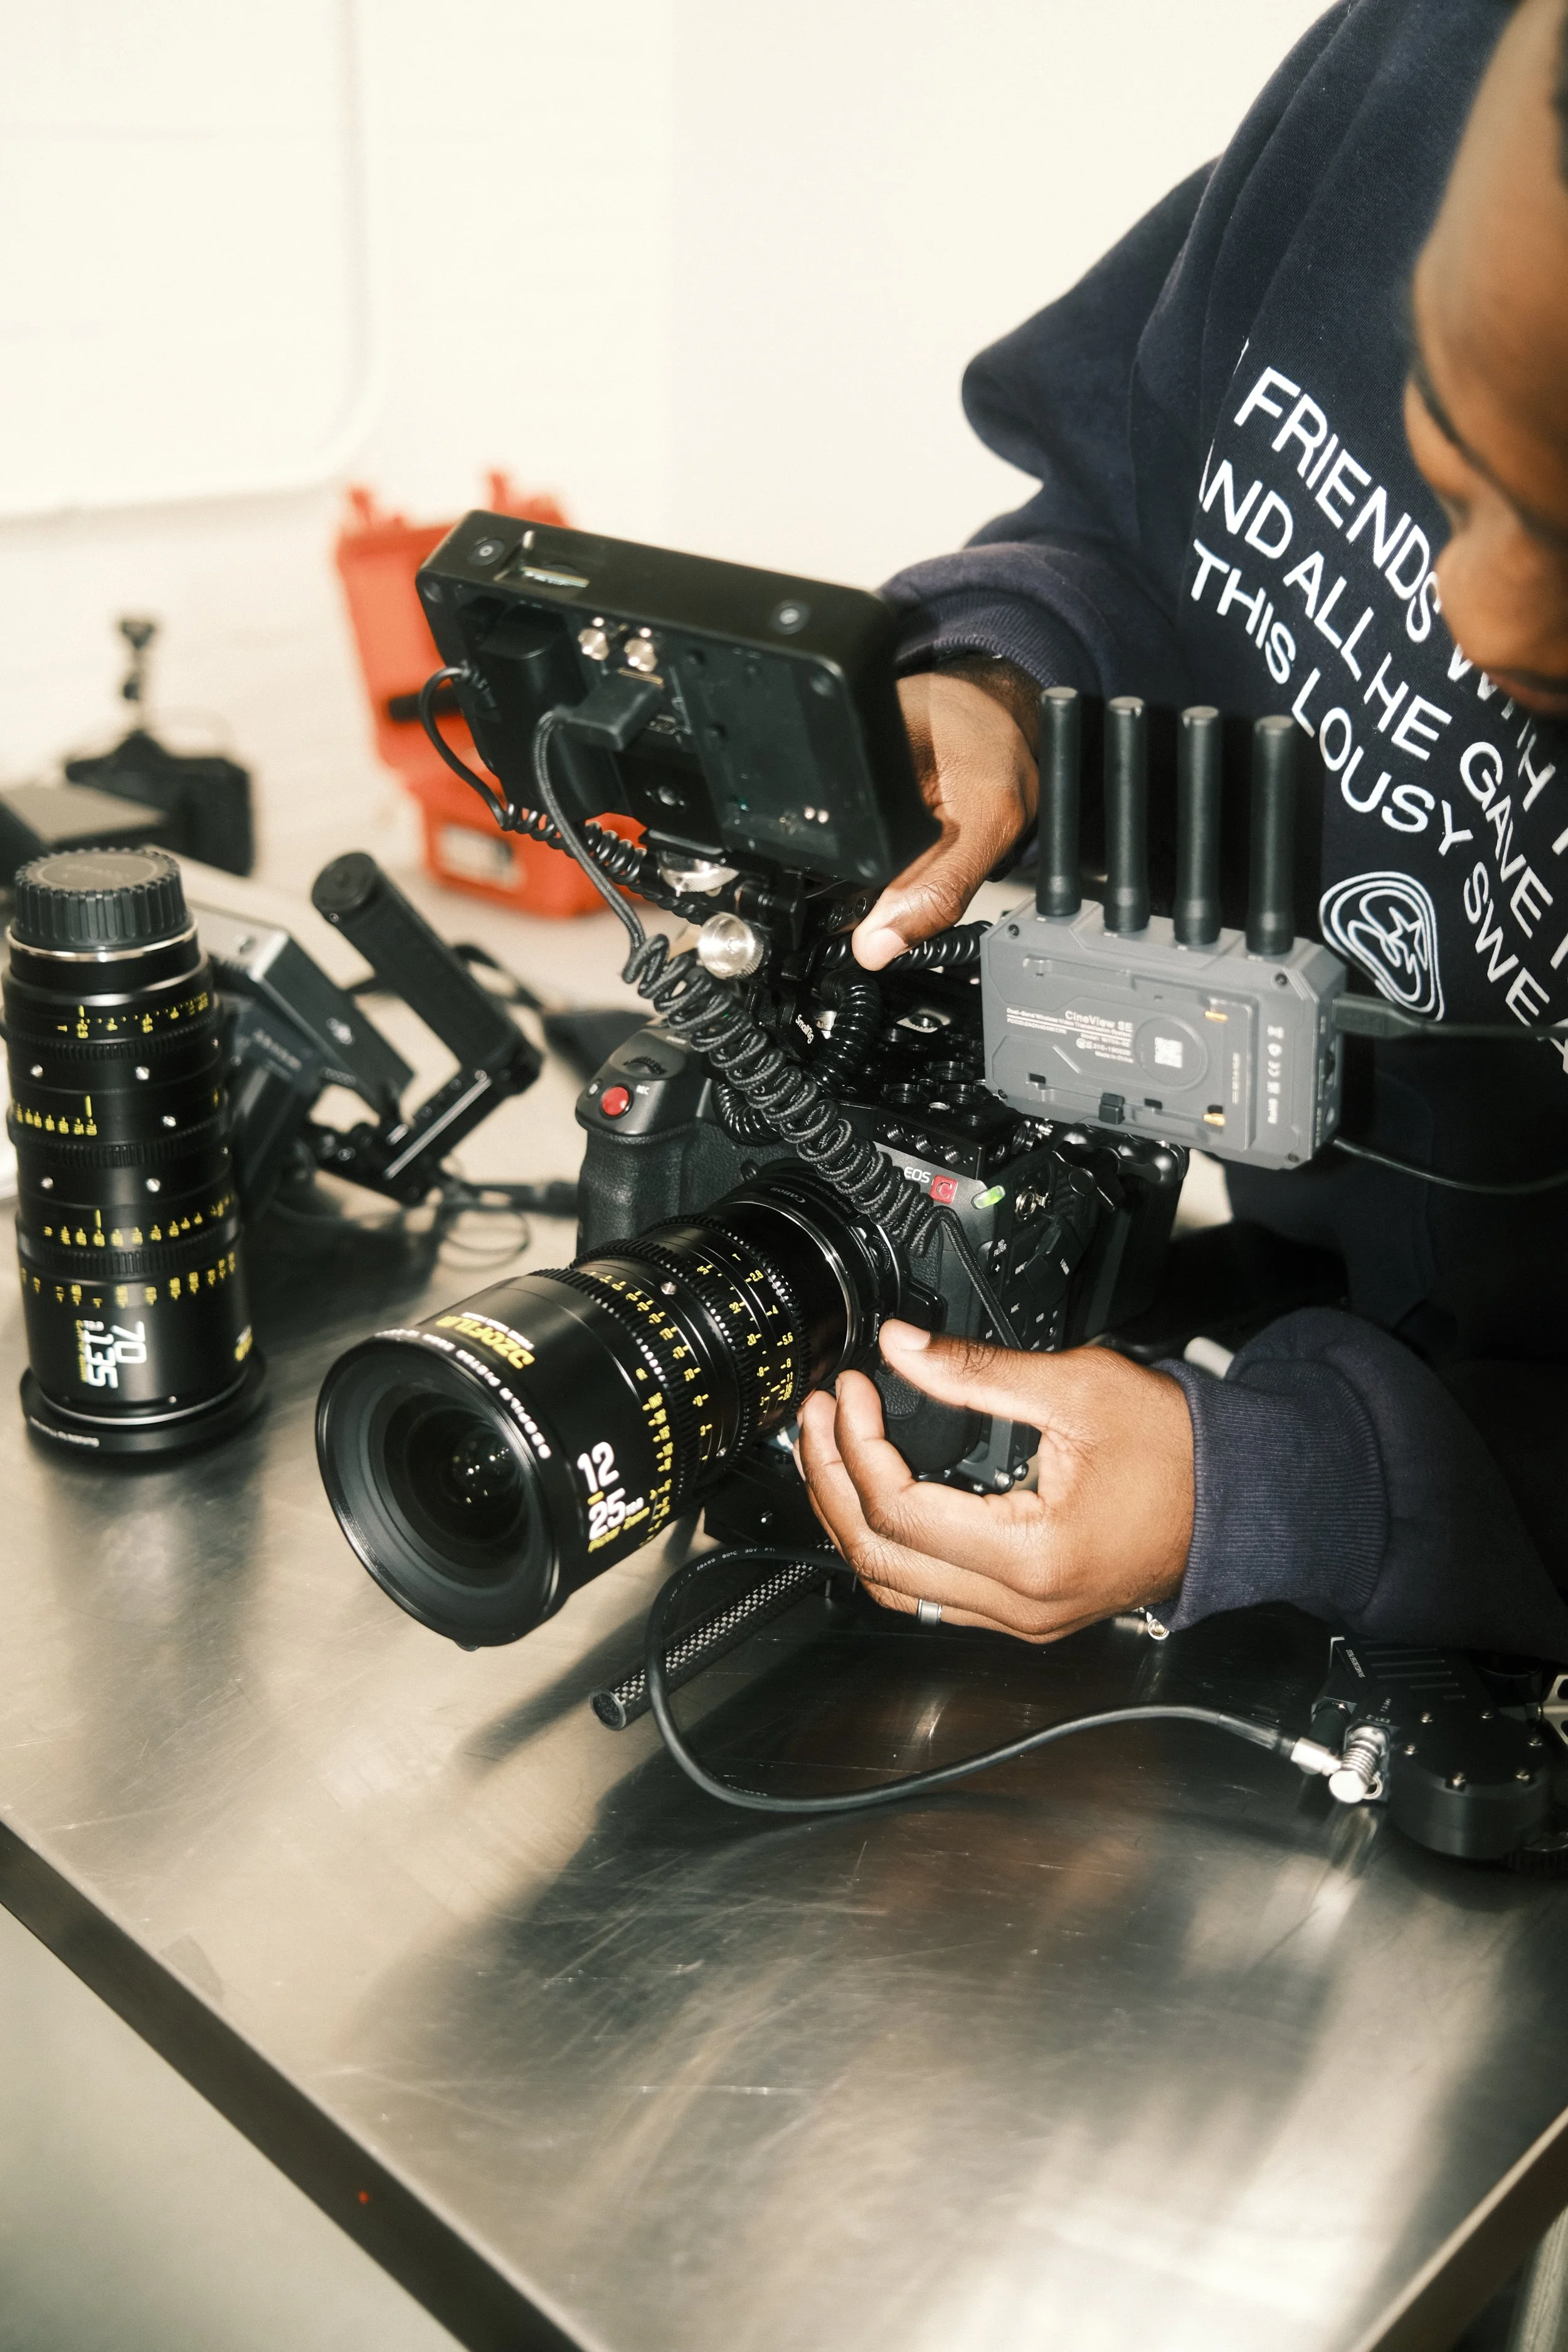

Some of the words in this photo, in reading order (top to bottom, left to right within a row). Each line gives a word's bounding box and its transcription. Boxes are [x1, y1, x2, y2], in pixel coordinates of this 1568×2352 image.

[1234, 366, 1441, 643] FRIENDS
[1191, 538, 1296, 685] THIS
[1291, 667, 1474, 857] LOUSY
[1199, 439, 1294, 559] ND
[1283, 550, 1374, 682] ALL
[1363, 652, 1453, 761] HE
[1459, 741, 1554, 938] GAVE
[795, 1014, 814, 1044] SmallRig
[1065, 1010, 1115, 1029] CineView
[636, 1084, 650, 1095] REC
[904, 1167, 931, 1184] EOS
[770, 1187, 806, 1203] Canon
[993, 1243, 1007, 1257] FILTER
[750, 1269, 765, 1282] 2.8
[771, 1305, 779, 1315] 4
[110, 1320, 147, 1364] 70
[435, 1315, 535, 1370] DZOFILM
[782, 1332, 794, 1346] 5.6
[82, 1329, 119, 1389] 135
[786, 1358, 792, 1368] 8
[787, 1371, 794, 1383] 11
[577, 1441, 620, 1494] 12
[588, 1486, 626, 1541] 25
